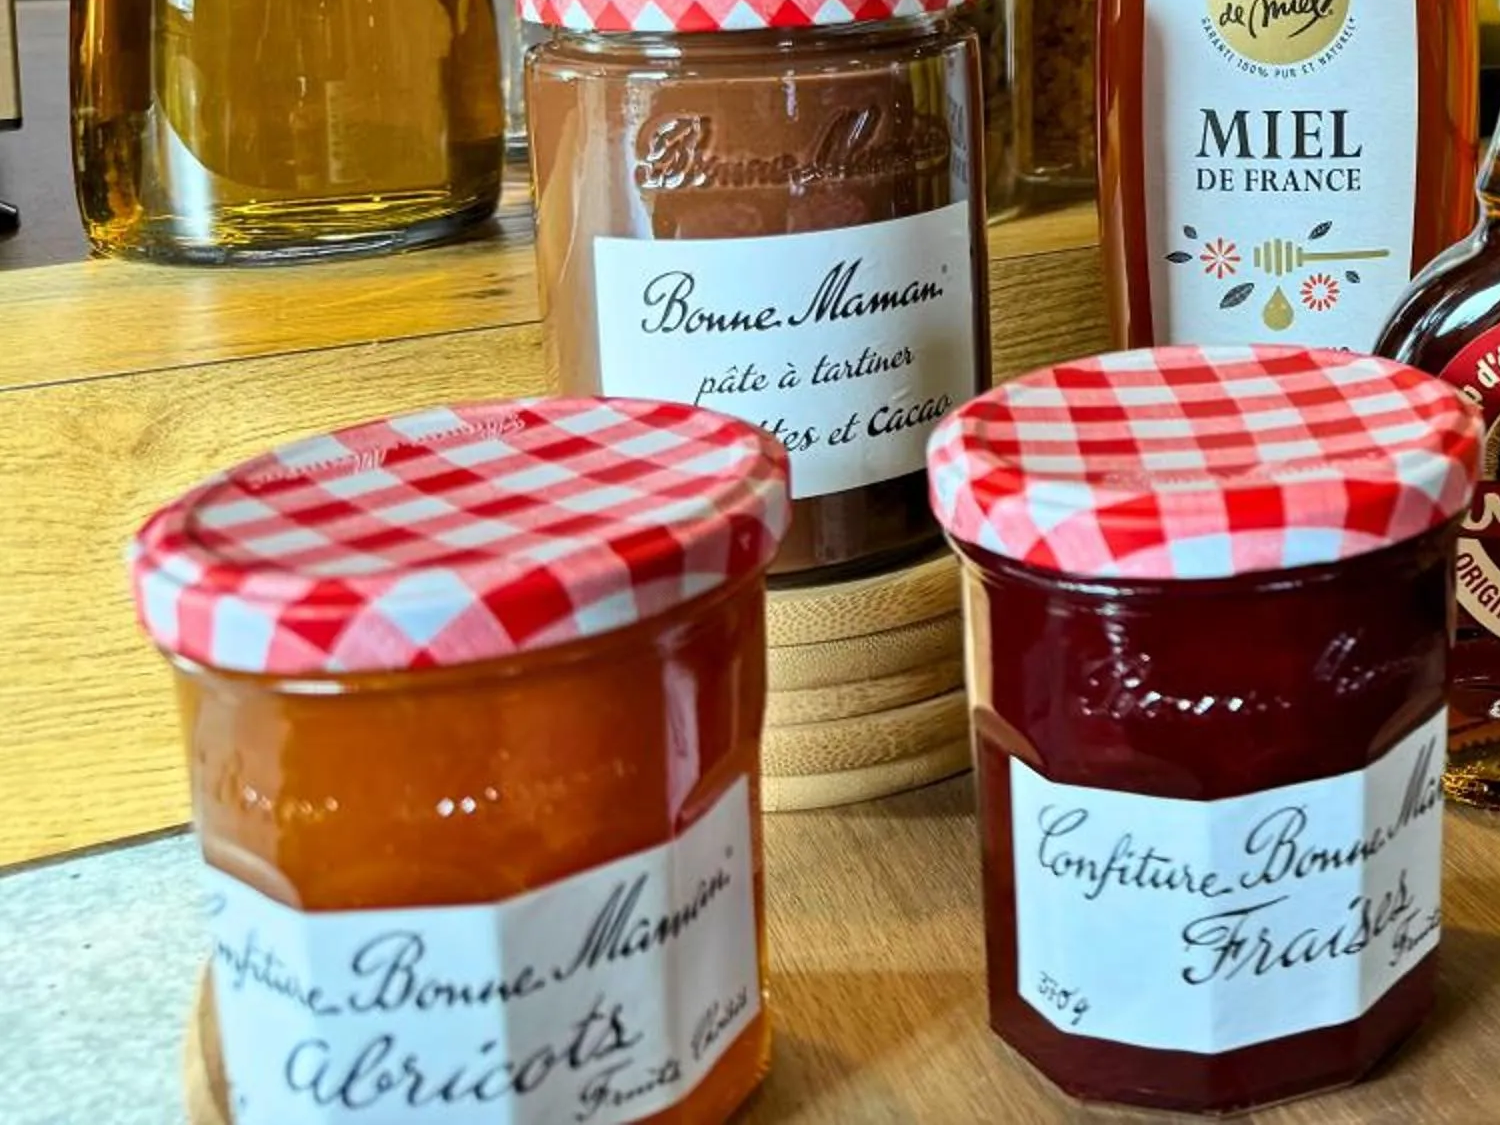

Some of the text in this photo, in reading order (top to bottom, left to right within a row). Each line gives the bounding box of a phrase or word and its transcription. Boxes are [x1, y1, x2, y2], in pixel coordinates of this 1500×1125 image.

[1219, 2, 1246, 27] de
[1274, 67, 1298, 79] PUR
[1302, 63, 1315, 74] ET
[1197, 108, 1363, 160] MIEL
[1197, 167, 1362, 192] DE FRANCE
[642, 256, 944, 335] Bonne Maman
[694, 344, 917, 406] pâte à tartiner
[828, 412, 861, 447] et
[867, 394, 953, 438] Cacao
[1038, 803, 1231, 901] Confiture
[1241, 805, 1385, 890] Bonne
[1181, 870, 1416, 985] Fraises
[347, 929, 545, 1012] Bonne
